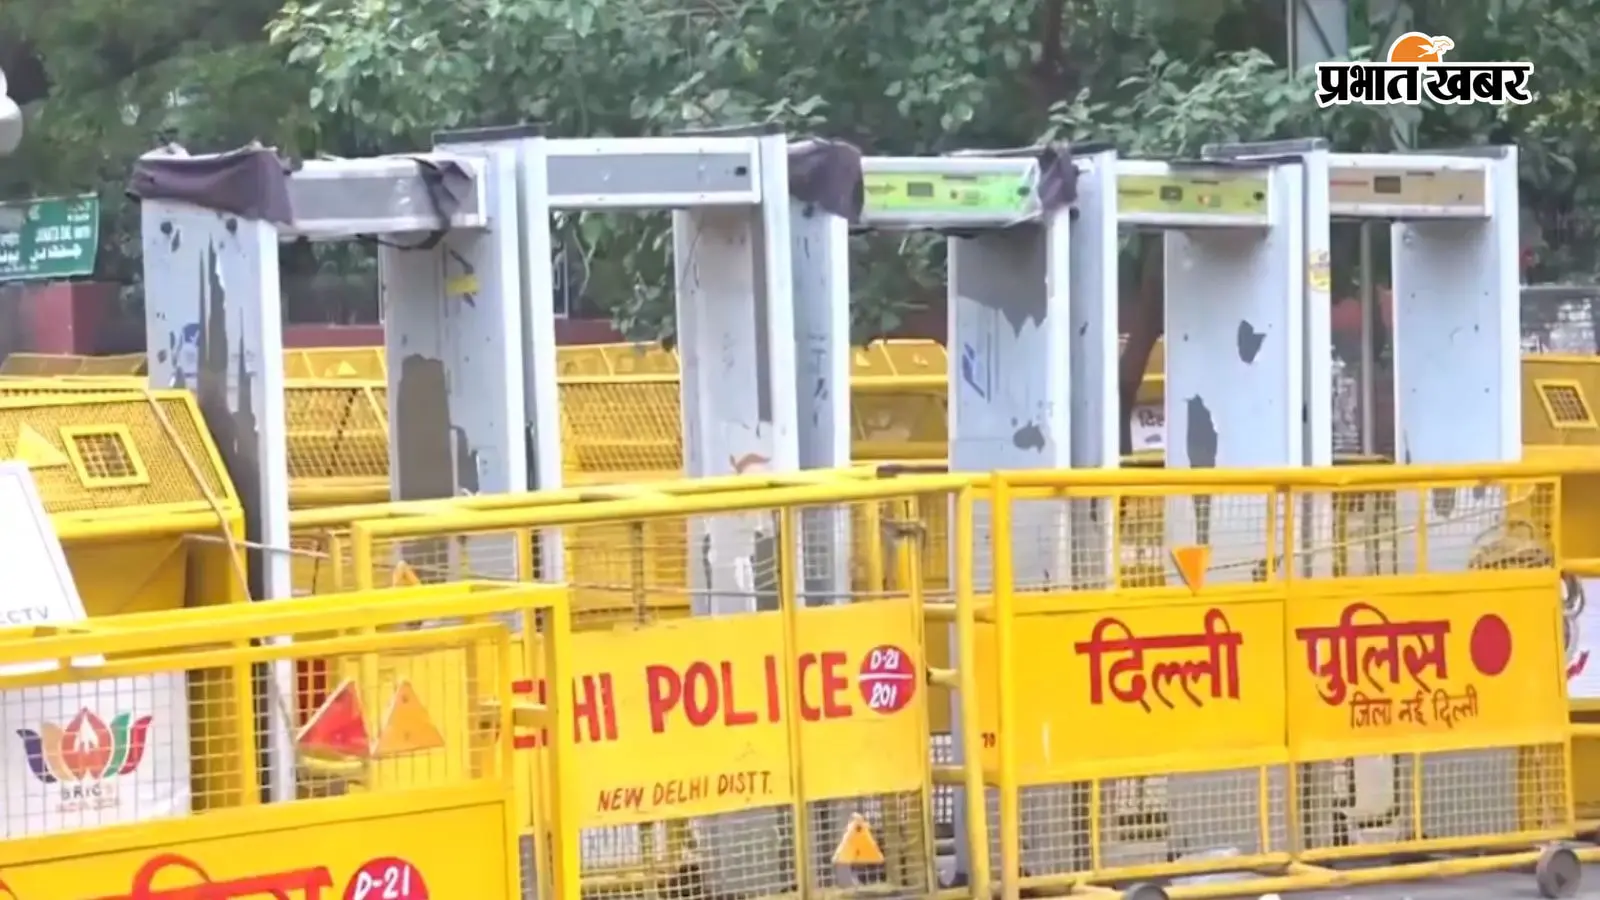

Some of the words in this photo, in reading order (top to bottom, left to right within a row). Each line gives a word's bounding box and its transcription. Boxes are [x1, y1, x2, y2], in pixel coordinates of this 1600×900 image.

[1074, 608, 1243, 713] दिल्ली
[1294, 602, 1451, 706] पुलिस
[646, 651, 853, 734] POLICE
[869, 682, 898, 708] 201
[1432, 684, 1478, 728] दिल्ली
[597, 787, 644, 812] NEW
[653, 775, 709, 806] DELHI
